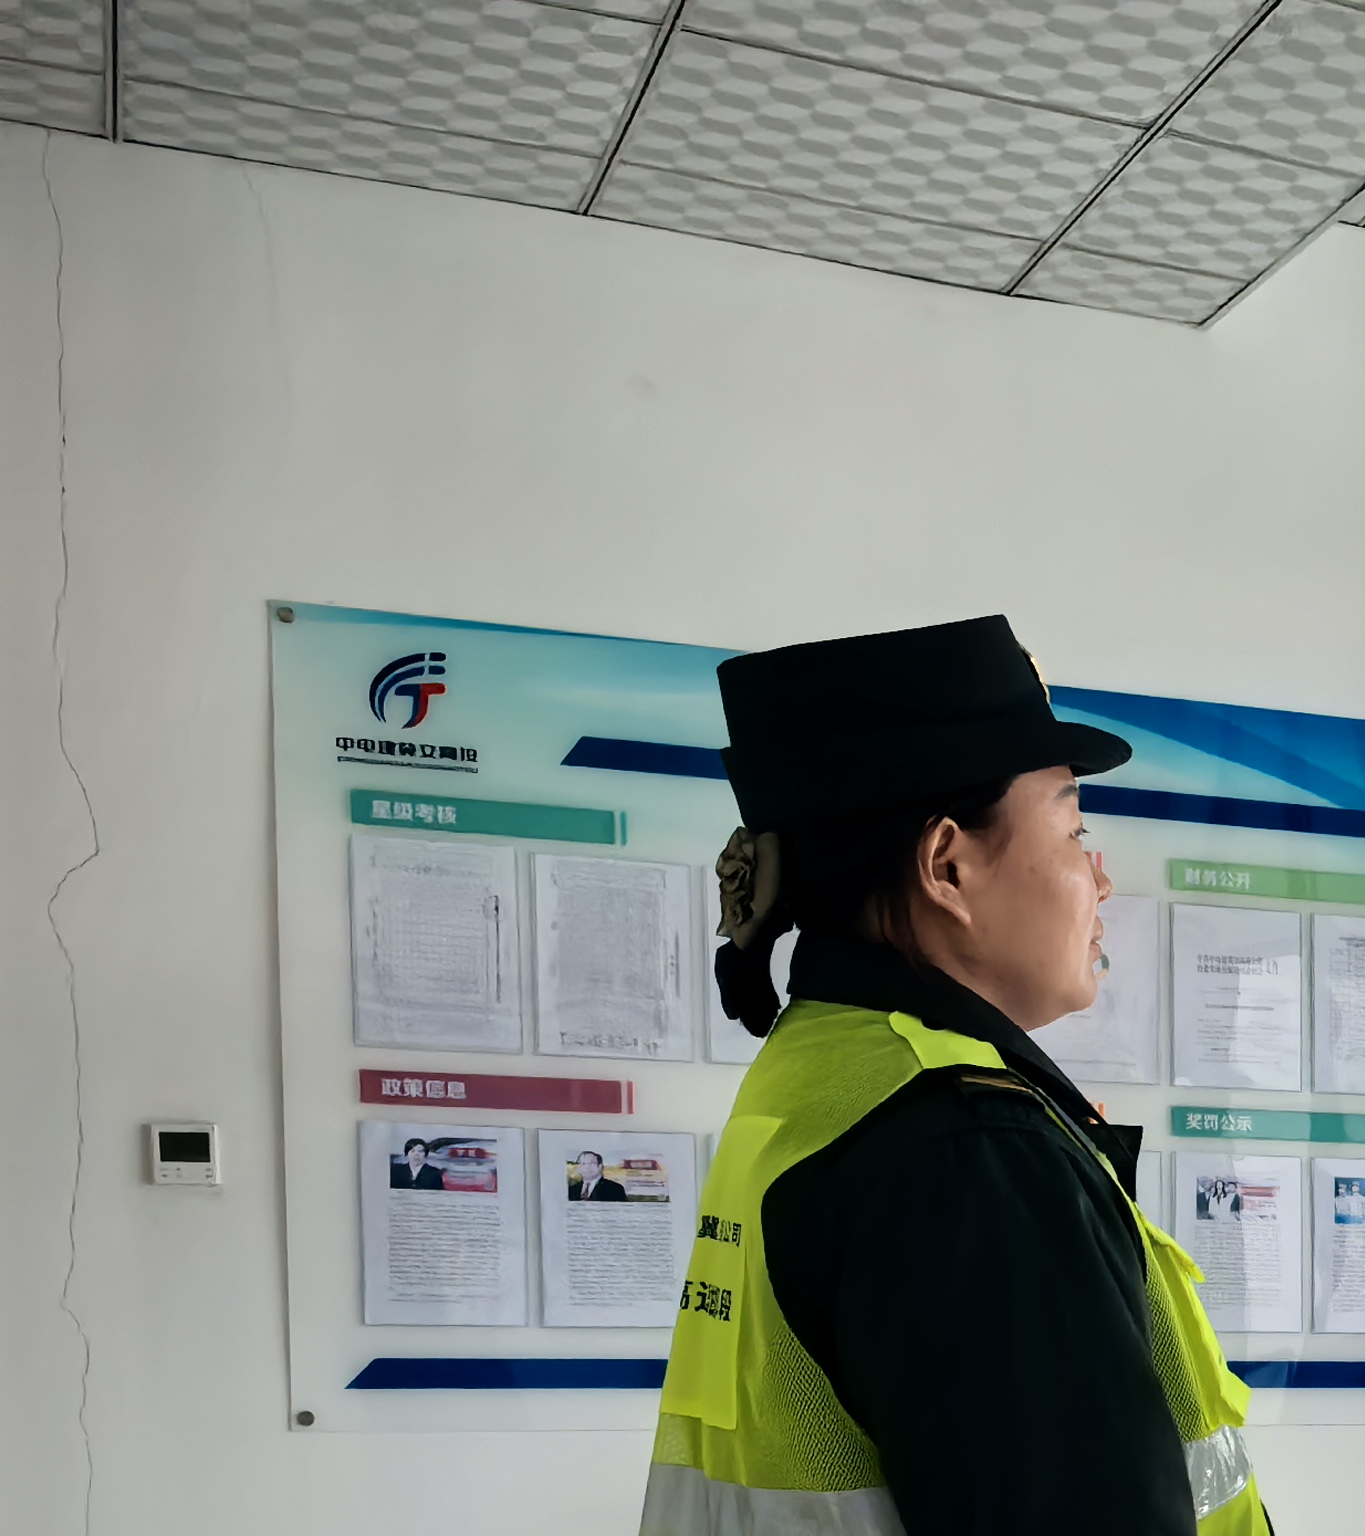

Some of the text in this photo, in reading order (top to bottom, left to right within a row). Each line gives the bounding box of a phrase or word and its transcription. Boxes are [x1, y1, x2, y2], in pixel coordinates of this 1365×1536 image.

[1185, 867, 1250, 889] 财务公开
[381, 1078, 467, 1099] 政策信息
[1186, 1112, 1252, 1132] 奖罚公示
